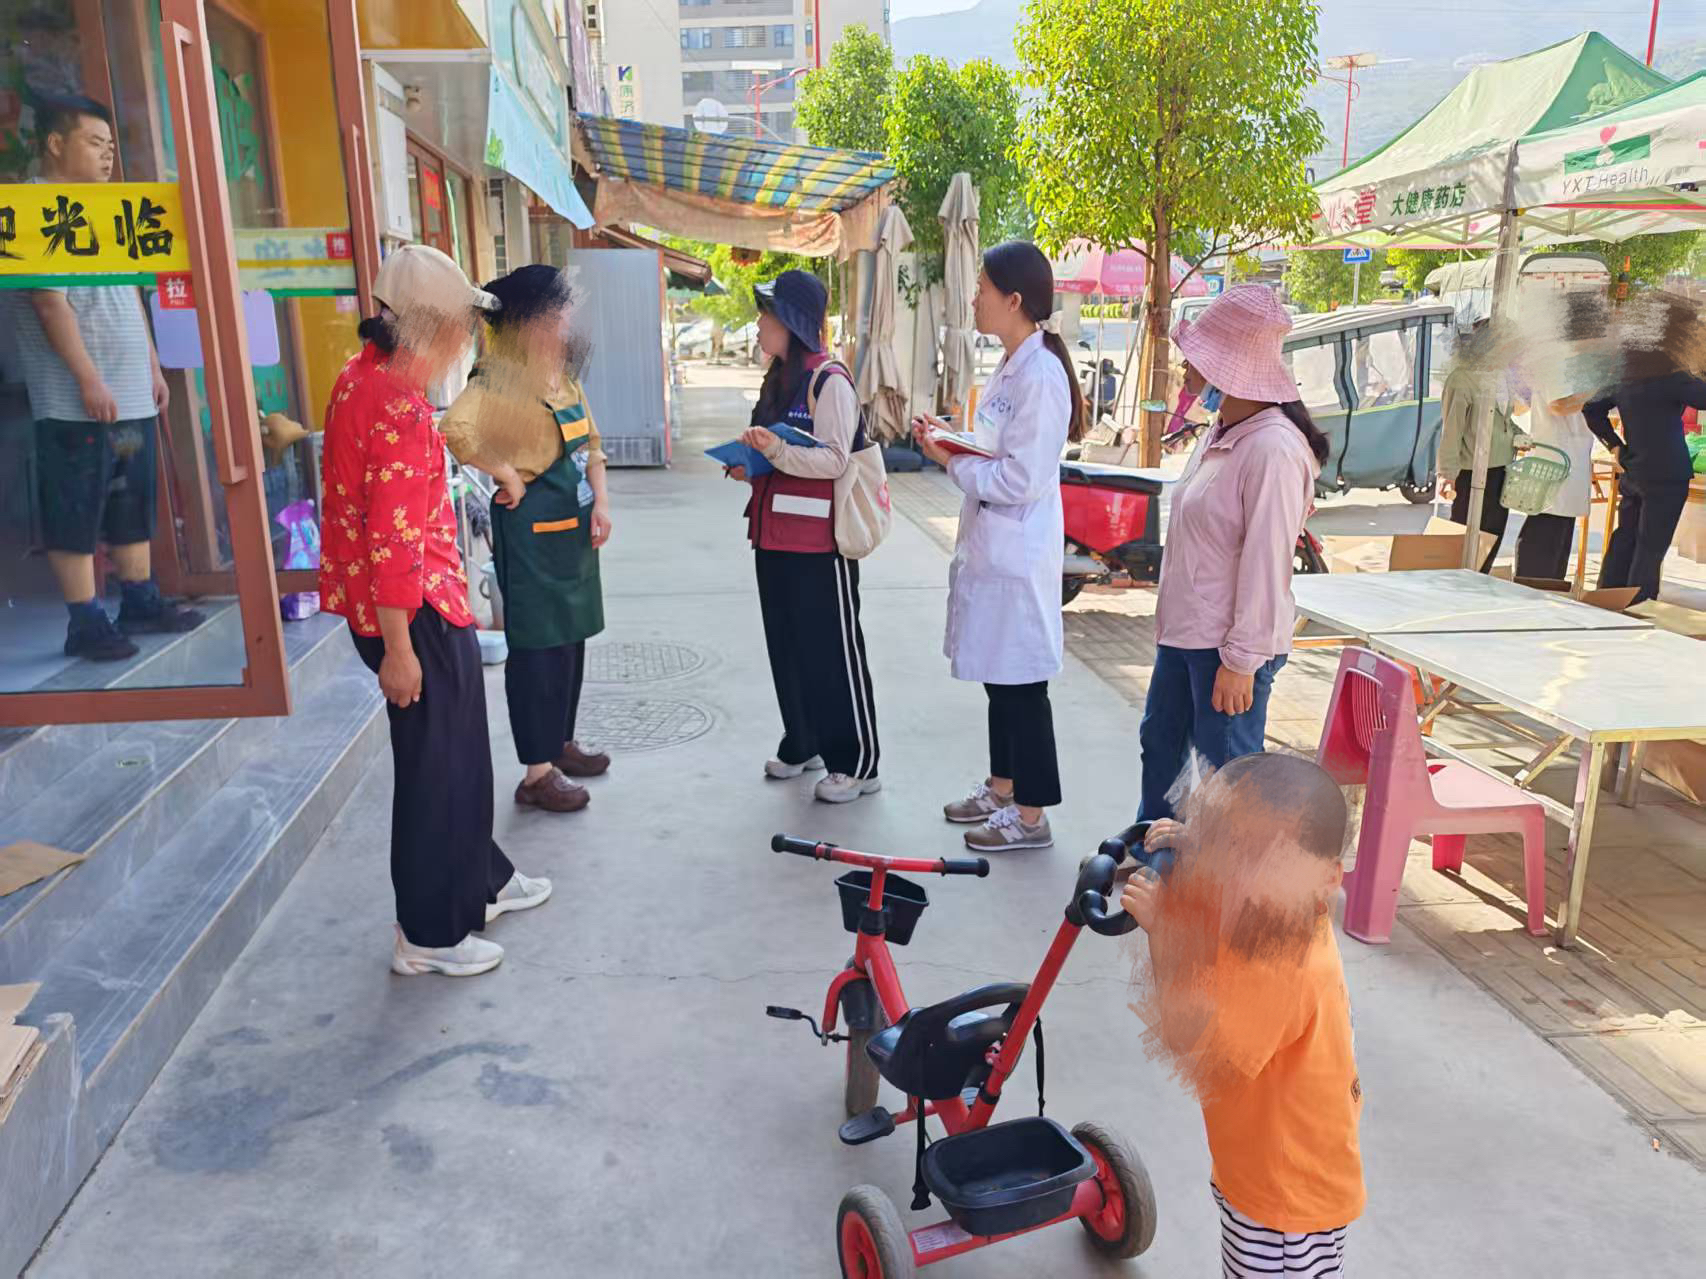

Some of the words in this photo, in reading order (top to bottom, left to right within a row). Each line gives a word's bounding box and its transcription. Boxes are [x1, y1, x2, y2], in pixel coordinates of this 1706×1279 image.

[1600, 167, 1648, 188] Health
[1390, 181, 1467, 217] 大健康药店
